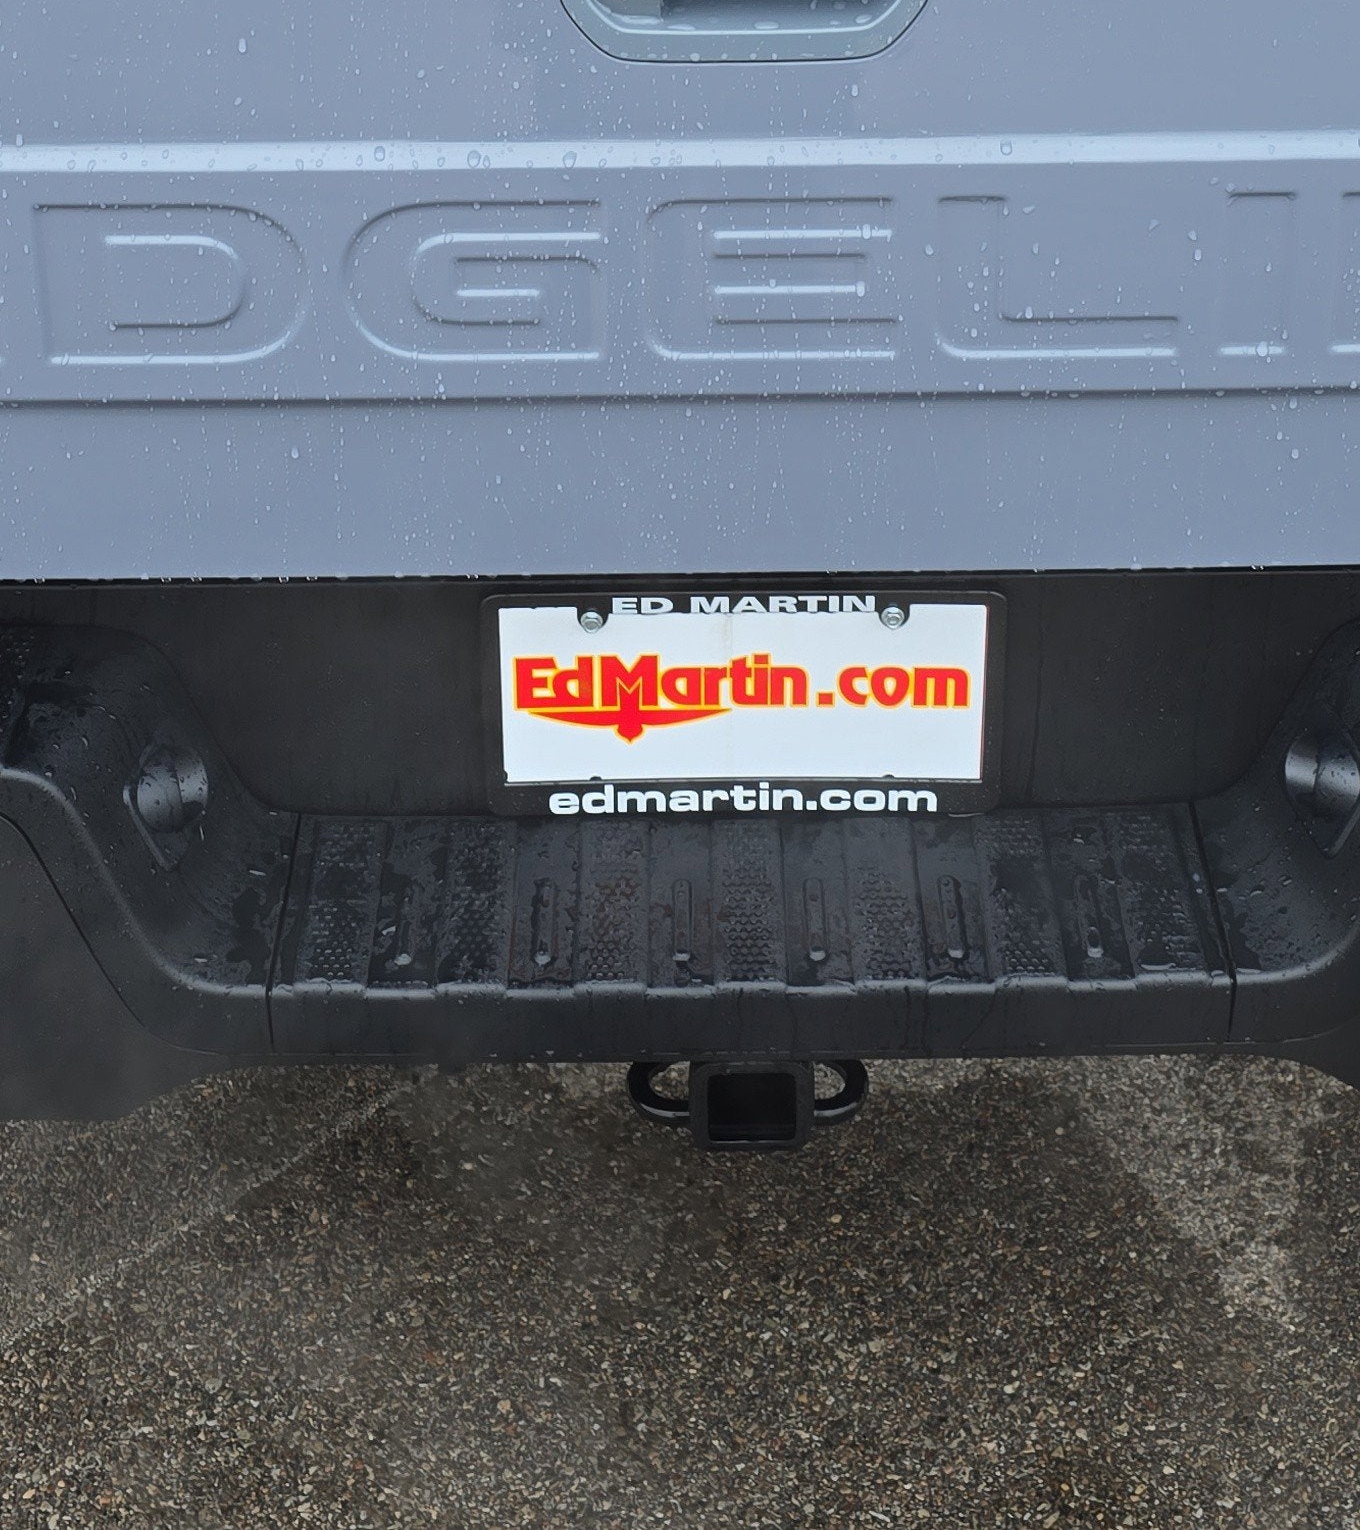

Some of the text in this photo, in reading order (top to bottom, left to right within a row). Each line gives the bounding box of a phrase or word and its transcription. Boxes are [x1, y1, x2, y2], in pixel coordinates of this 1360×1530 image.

[611, 595, 876, 615] ED MARTIN
[548, 781, 939, 815] edmartin.com
